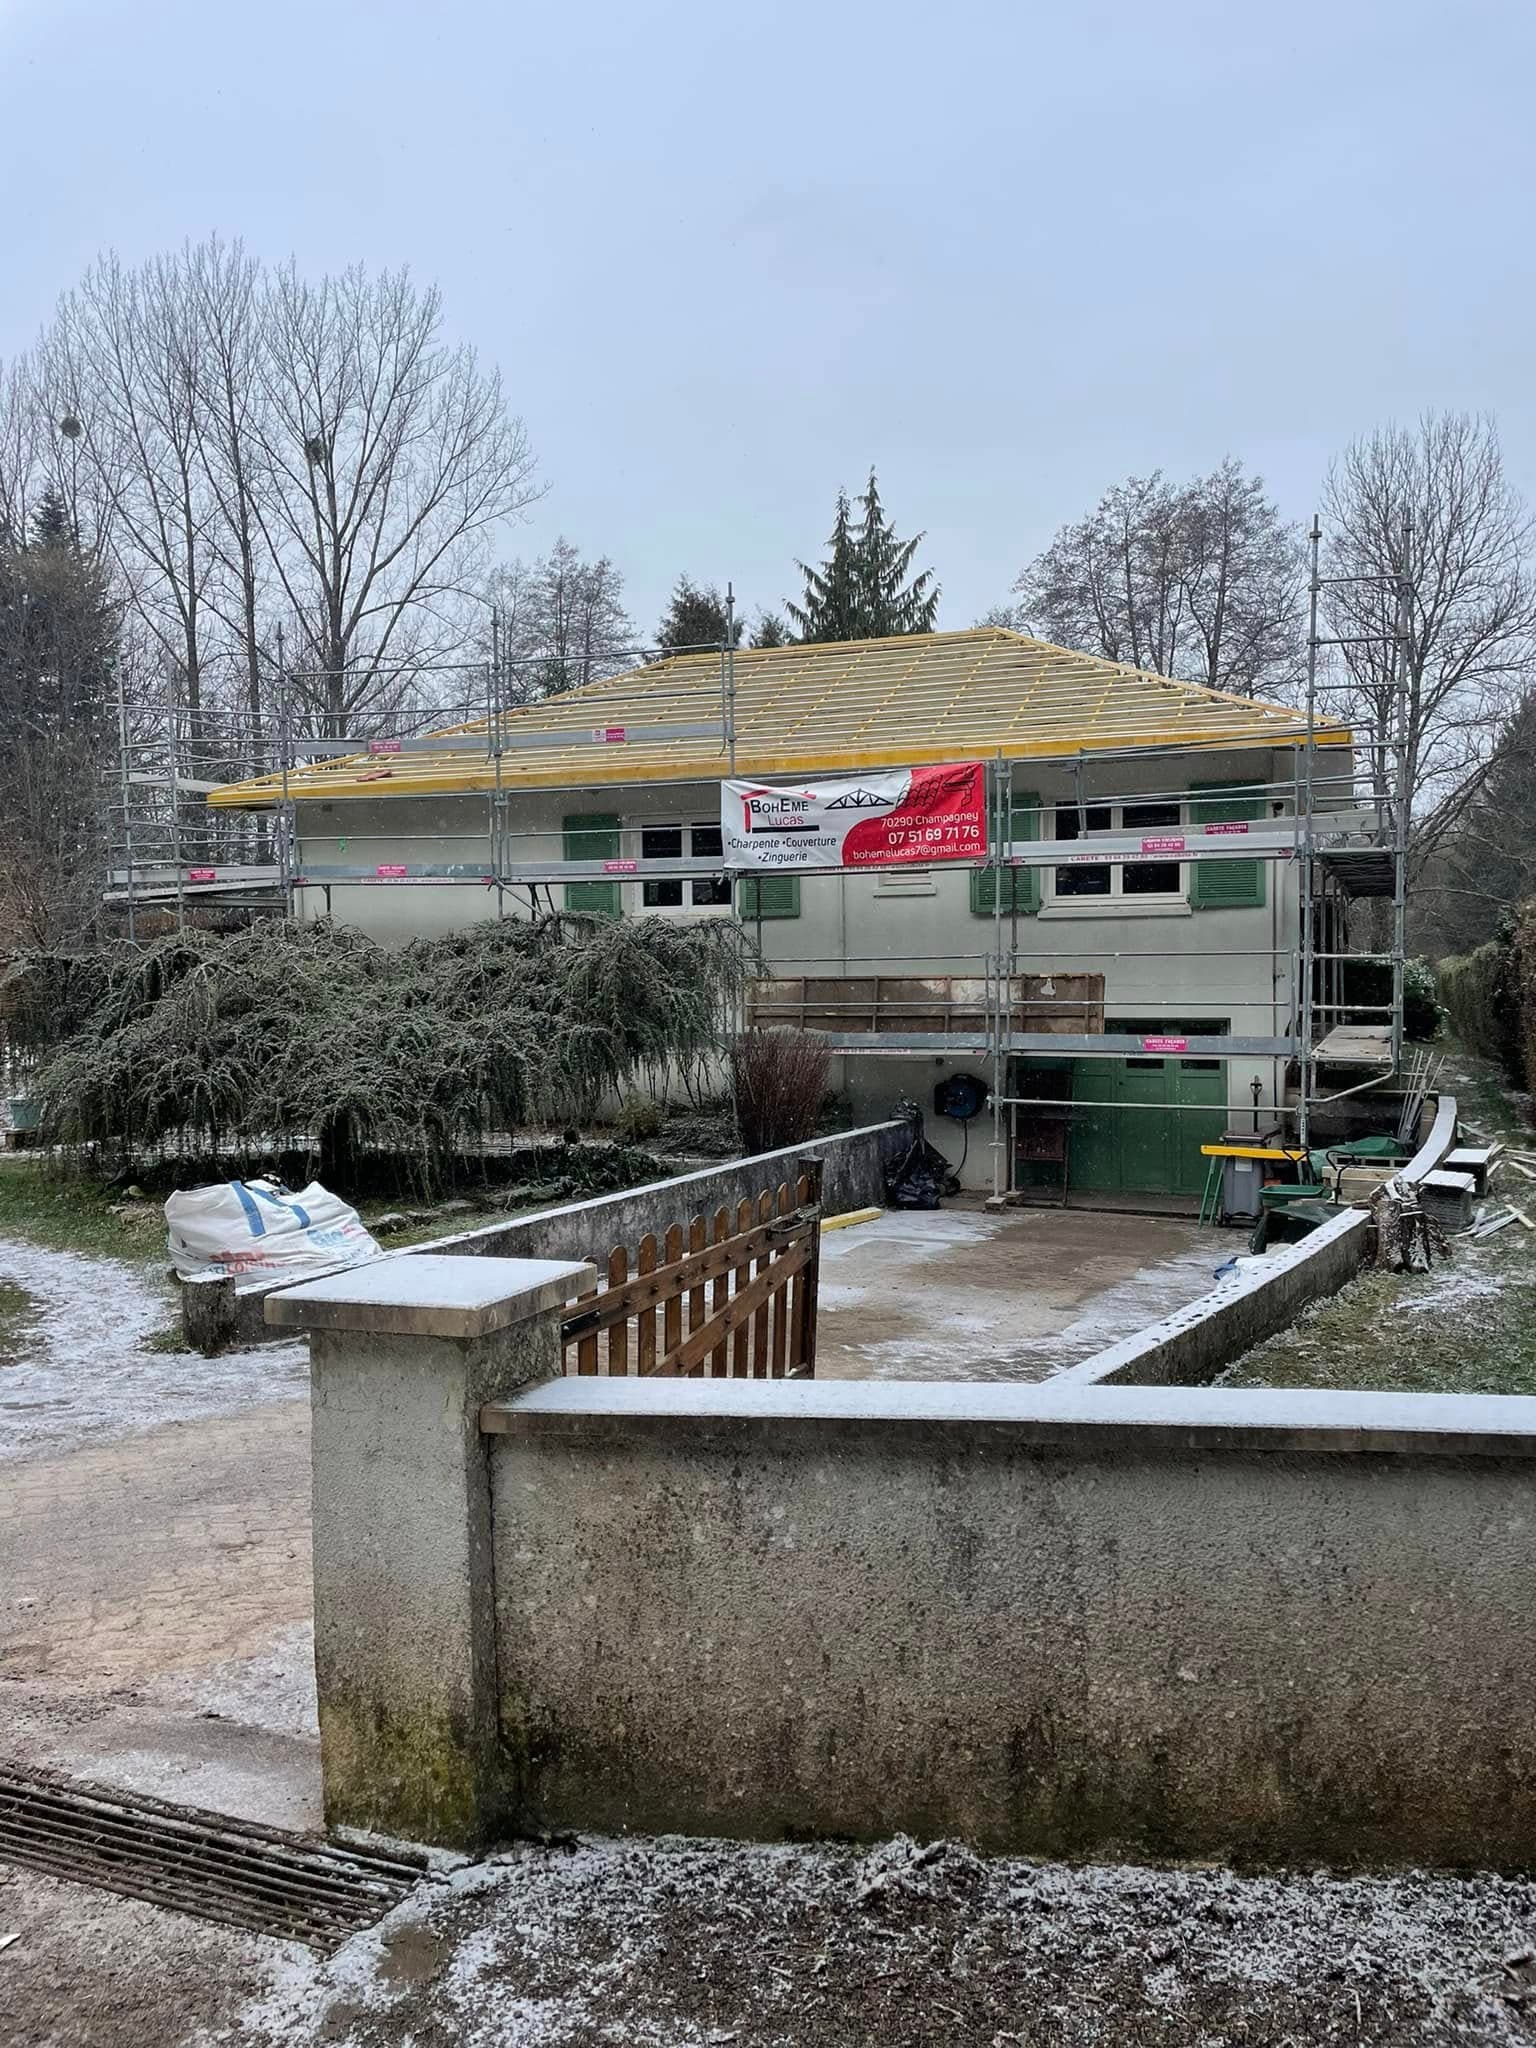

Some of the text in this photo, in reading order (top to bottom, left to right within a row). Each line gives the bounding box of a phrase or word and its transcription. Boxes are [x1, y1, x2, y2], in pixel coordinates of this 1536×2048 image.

[767, 814, 804, 826] Lucas
[881, 811, 979, 828] 70290 Champagney
[888, 825, 980, 845] 07 51 69 71 76
[731, 837, 837, 850] Charpente Couverture
[853, 842, 980, 860] bohemelucas7@gmail.com
[761, 852, 808, 864] Zinguerie
